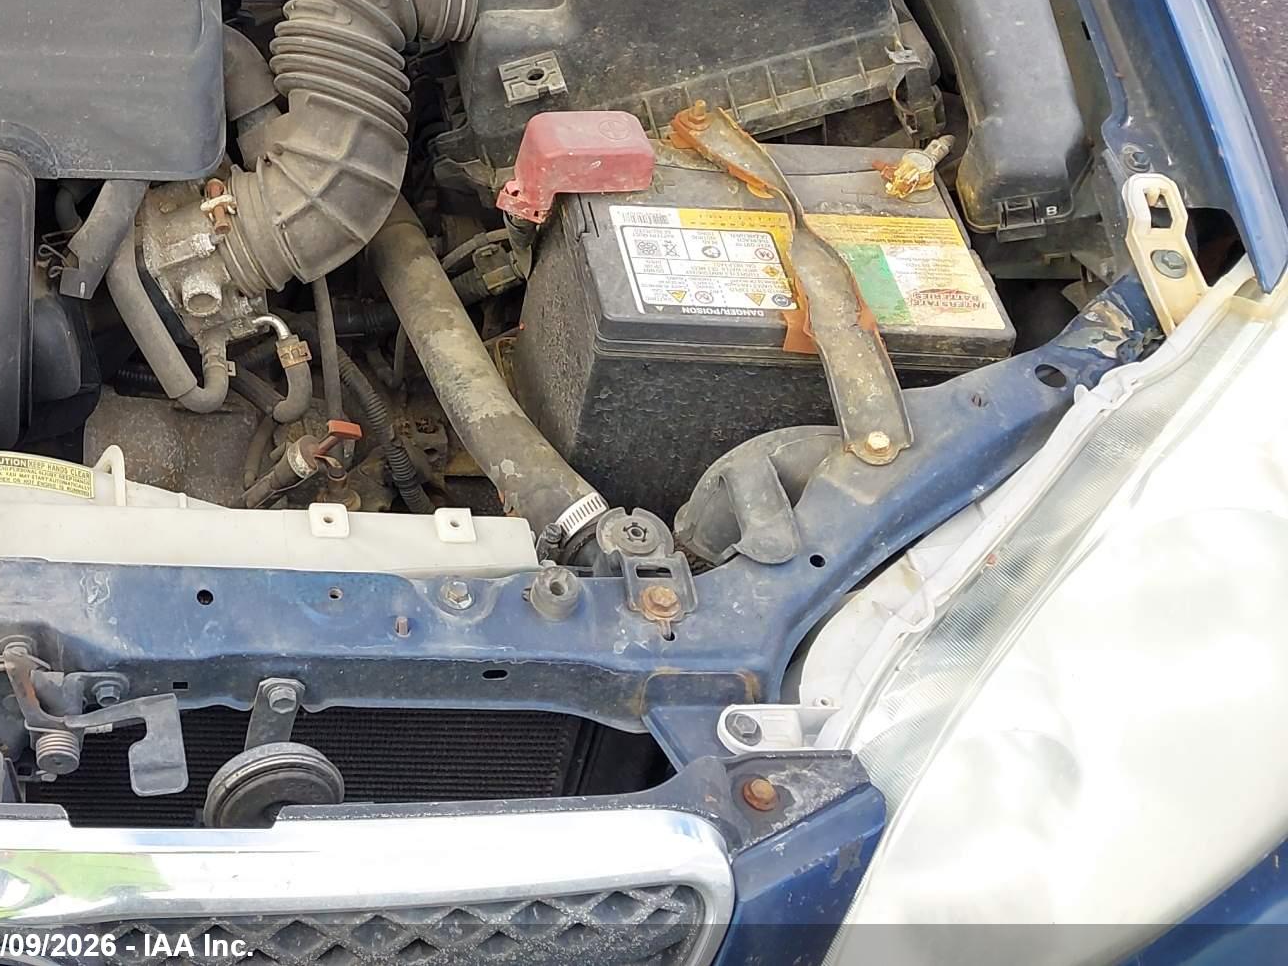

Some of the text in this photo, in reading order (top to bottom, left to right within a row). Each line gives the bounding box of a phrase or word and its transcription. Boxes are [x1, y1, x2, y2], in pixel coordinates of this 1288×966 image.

[1045, 205, 1058, 216] B
[912, 299, 985, 309] INTERSTATE
[681, 306, 765, 317] DANGER/POISON
[28, 459, 46, 470] KEEP
[48, 464, 68, 474] HANDS
[70, 469, 90, 479] CLEAR
